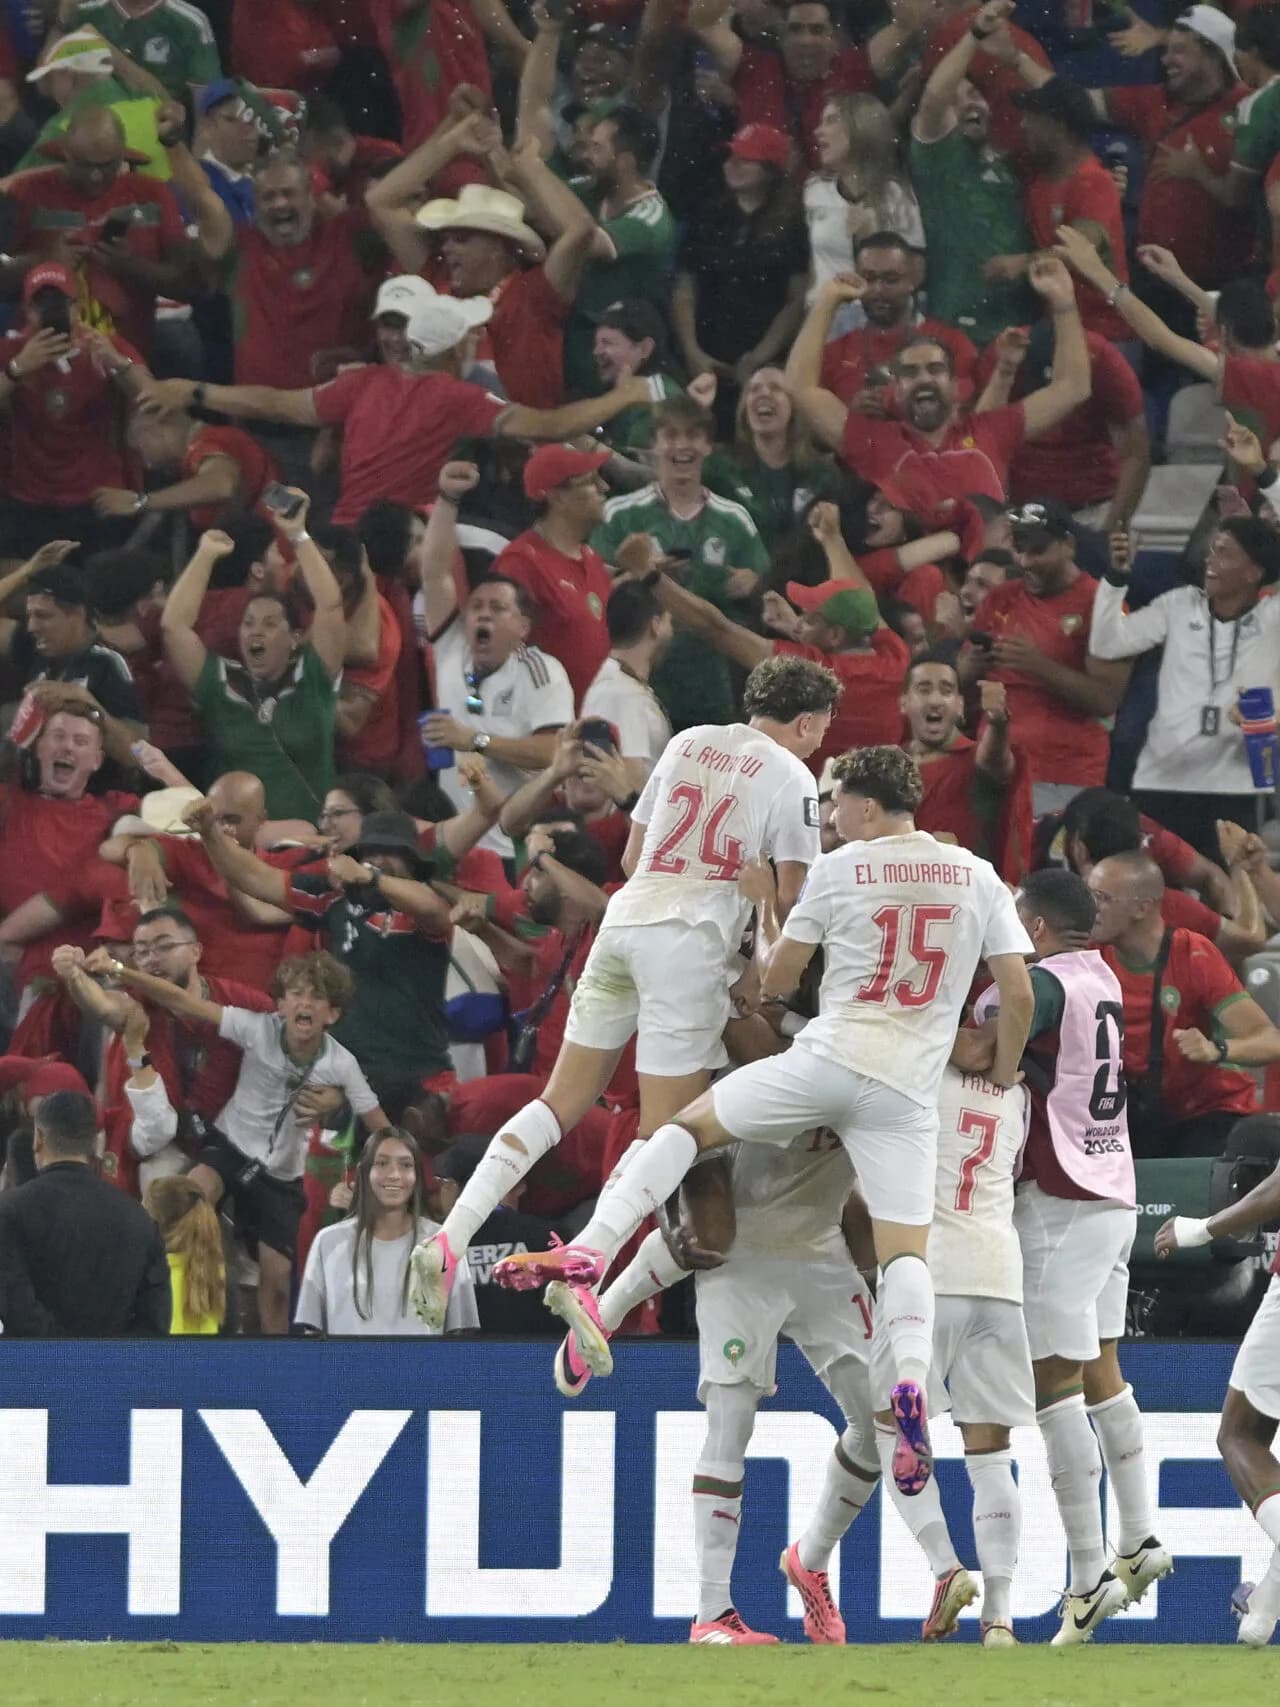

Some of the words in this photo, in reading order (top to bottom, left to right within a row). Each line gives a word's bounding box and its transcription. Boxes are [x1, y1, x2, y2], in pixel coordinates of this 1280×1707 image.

[648, 781, 743, 880] 24
[855, 864, 877, 885] EL
[883, 863, 972, 887] MOURABET
[853, 904, 961, 1010] 15
[1098, 1097, 1115, 1111] FIFA
[1085, 1126, 1109, 1138] WORLD
[1107, 1125, 1121, 1137] CUP
[1084, 1139, 1125, 1156] 2026
[954, 1107, 1003, 1216] 7
[1147, 1203, 1172, 1215] CUP
